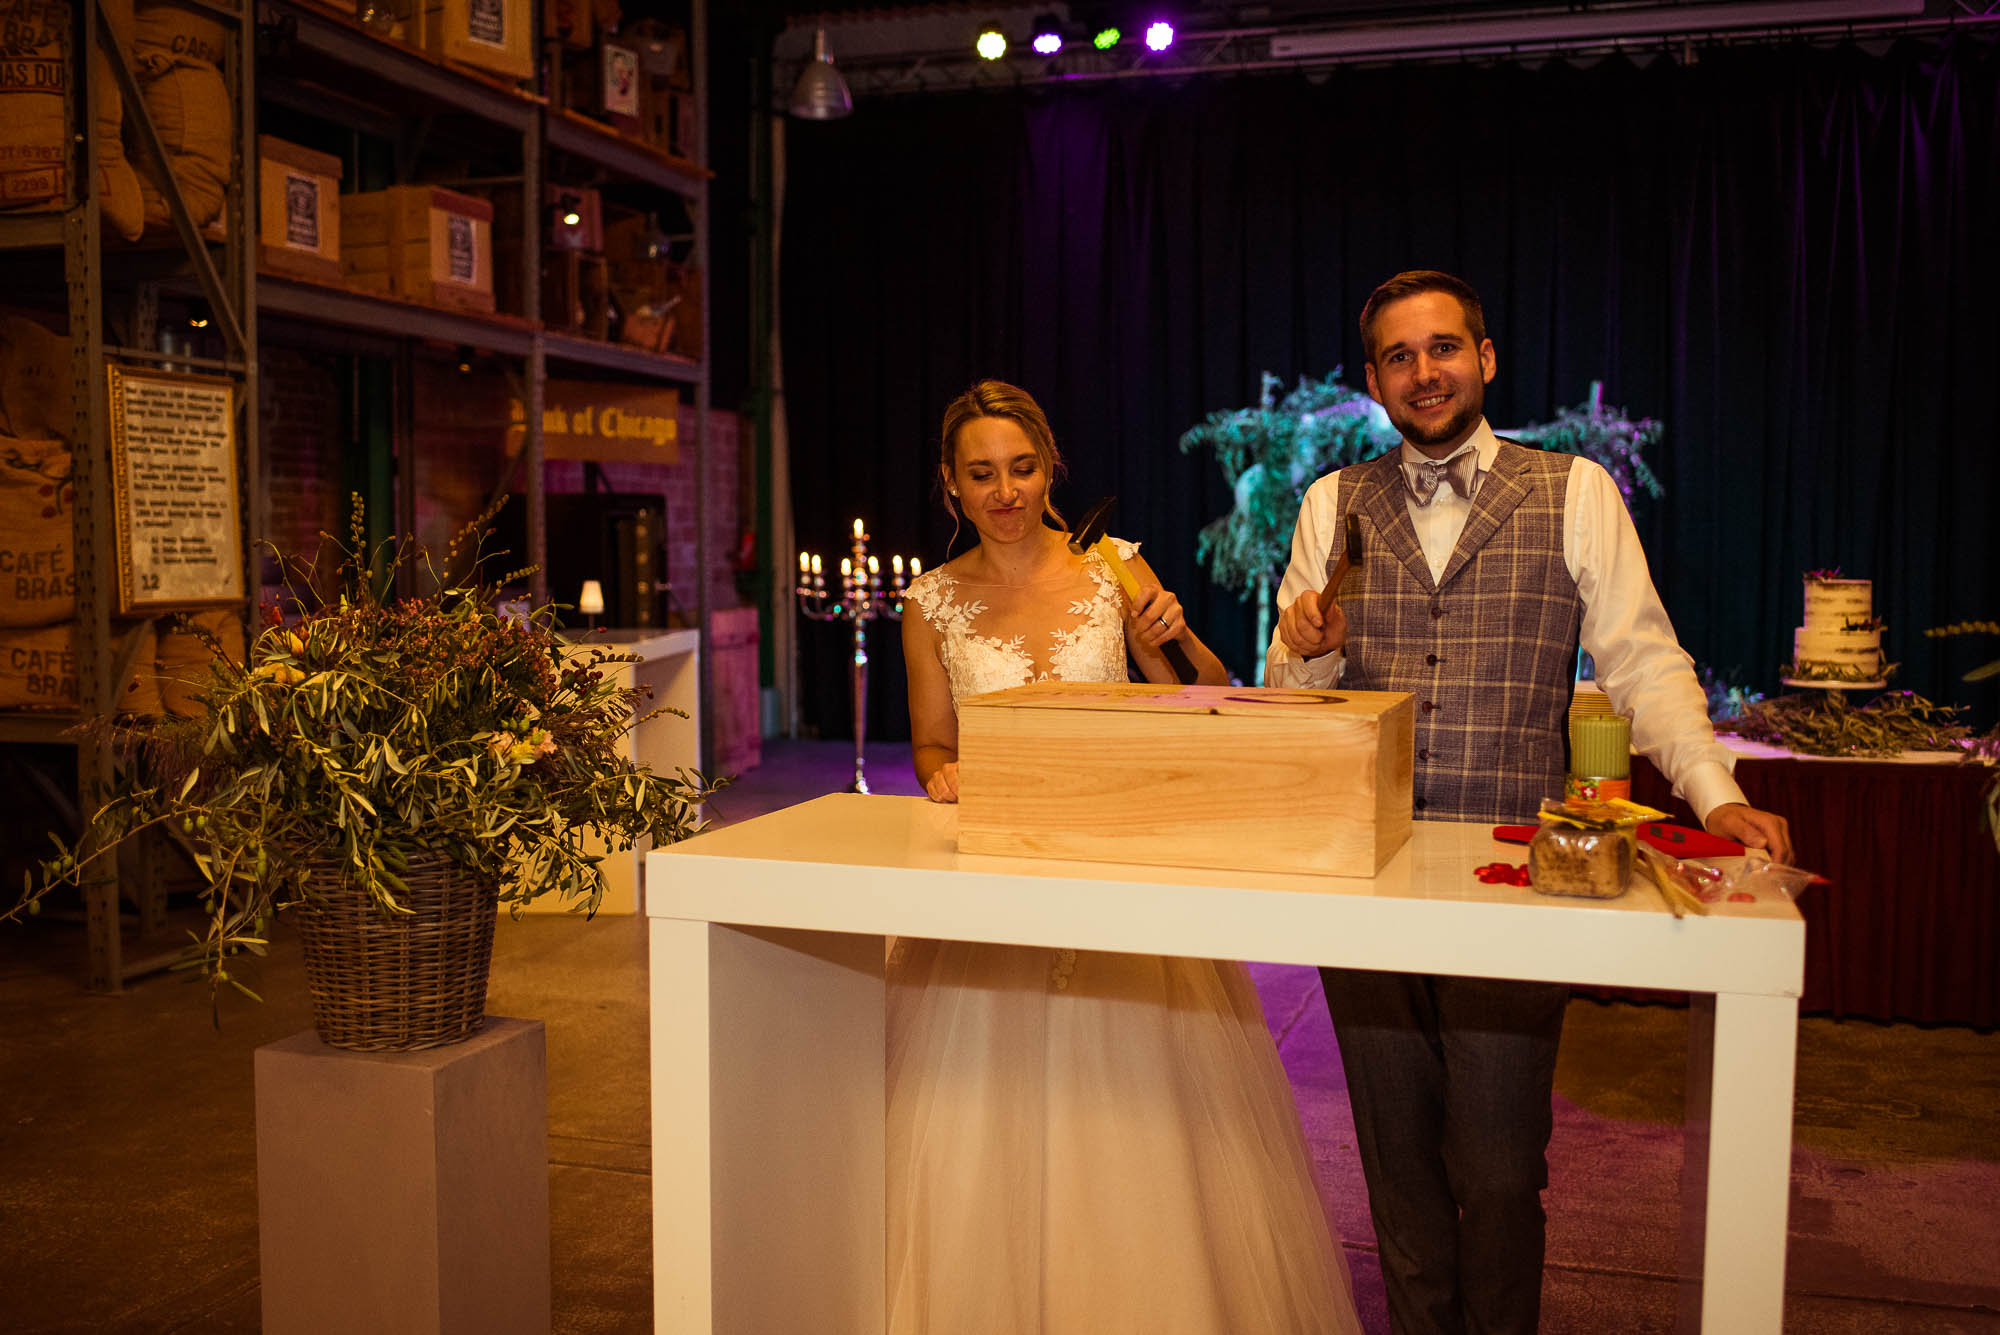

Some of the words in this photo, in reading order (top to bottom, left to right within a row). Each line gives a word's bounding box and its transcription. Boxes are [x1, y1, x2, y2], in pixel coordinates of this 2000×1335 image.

[0, 63, 29, 88] AS
[0, 543, 65, 574] CAFÉ
[141, 573, 161, 591] 12
[27, 673, 80, 699] BRA
